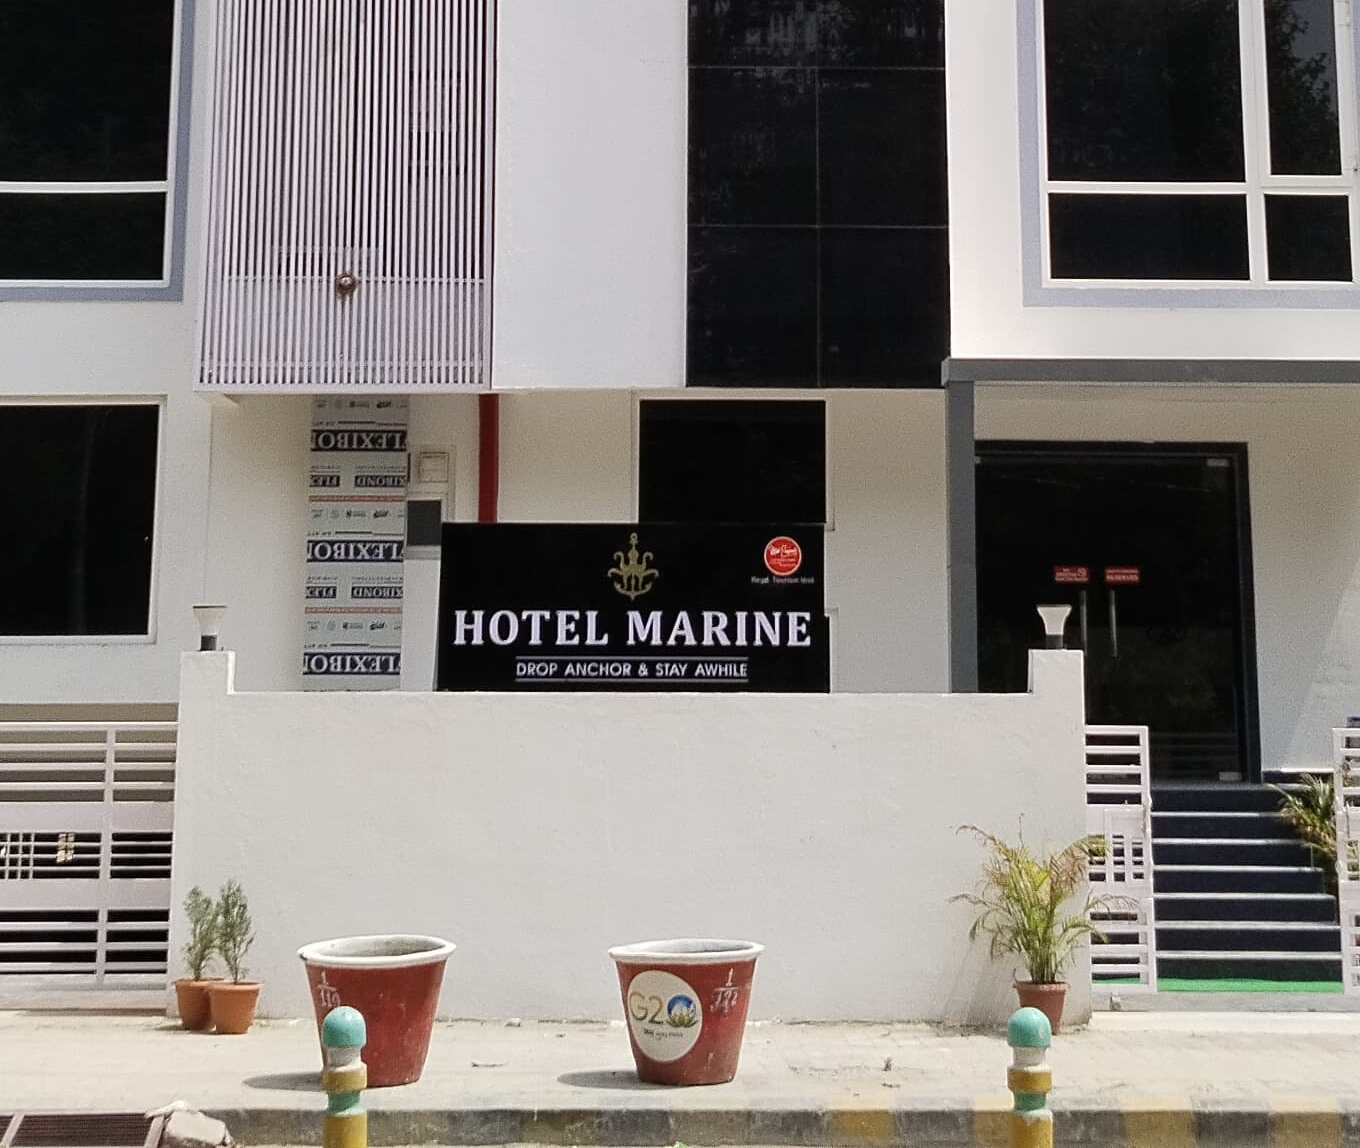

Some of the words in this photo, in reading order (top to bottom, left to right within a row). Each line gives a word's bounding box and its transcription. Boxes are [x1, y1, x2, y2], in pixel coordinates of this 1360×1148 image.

[453, 610, 608, 646] HOTEL
[627, 610, 812, 647] MARINE
[516, 663, 558, 677] DROP
[564, 663, 631, 677] ANCHOR
[638, 663, 649, 677] &
[655, 663, 687, 677] STAY
[694, 663, 747, 678] AWHILE
